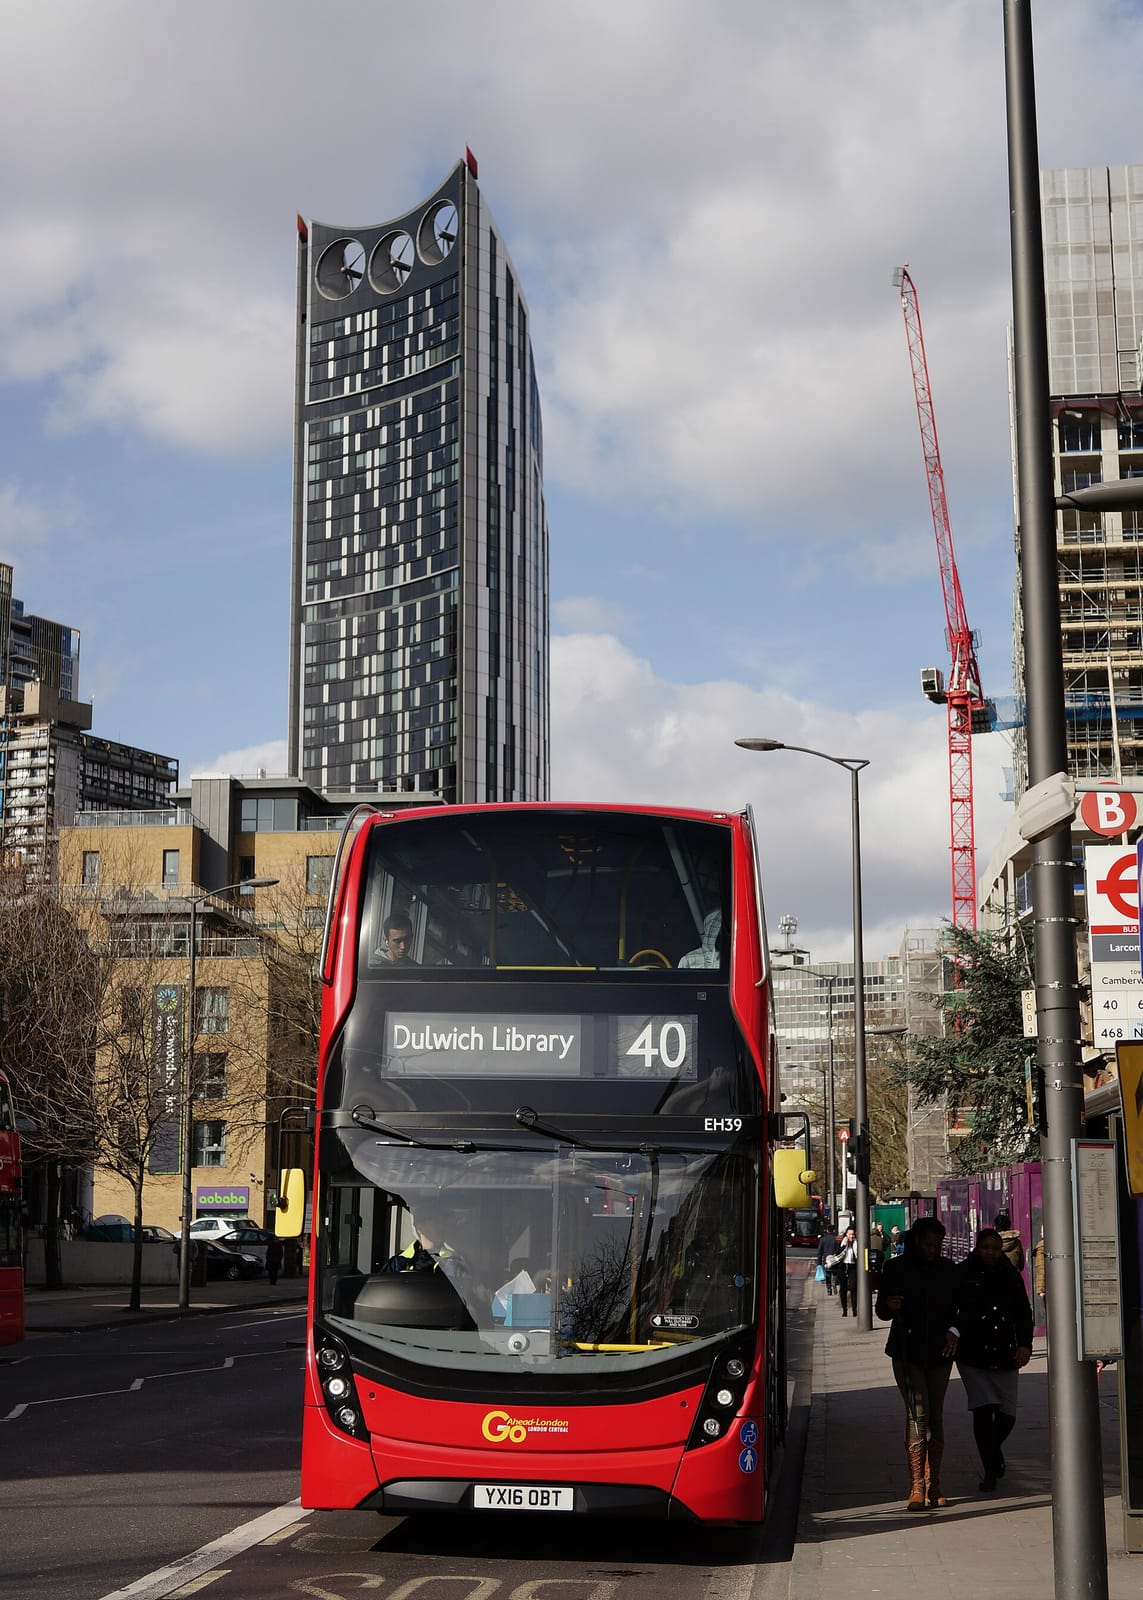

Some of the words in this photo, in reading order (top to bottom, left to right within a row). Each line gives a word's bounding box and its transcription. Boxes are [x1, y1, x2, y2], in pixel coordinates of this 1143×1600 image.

[1096, 792, 1126, 829] B
[1103, 999, 1118, 1010] 40
[1101, 1027, 1123, 1038] 468
[393, 1024, 483, 1051] Dulwich
[493, 1026, 574, 1060] Library
[626, 1020, 687, 1069] 40
[704, 1117, 743, 1132] EH39
[840, 1130, 849, 1139] A
[199, 1191, 246, 1204] aobaba
[482, 1410, 527, 1443] Go
[486, 1487, 523, 1505] YX16
[528, 1489, 562, 1507] OBT
